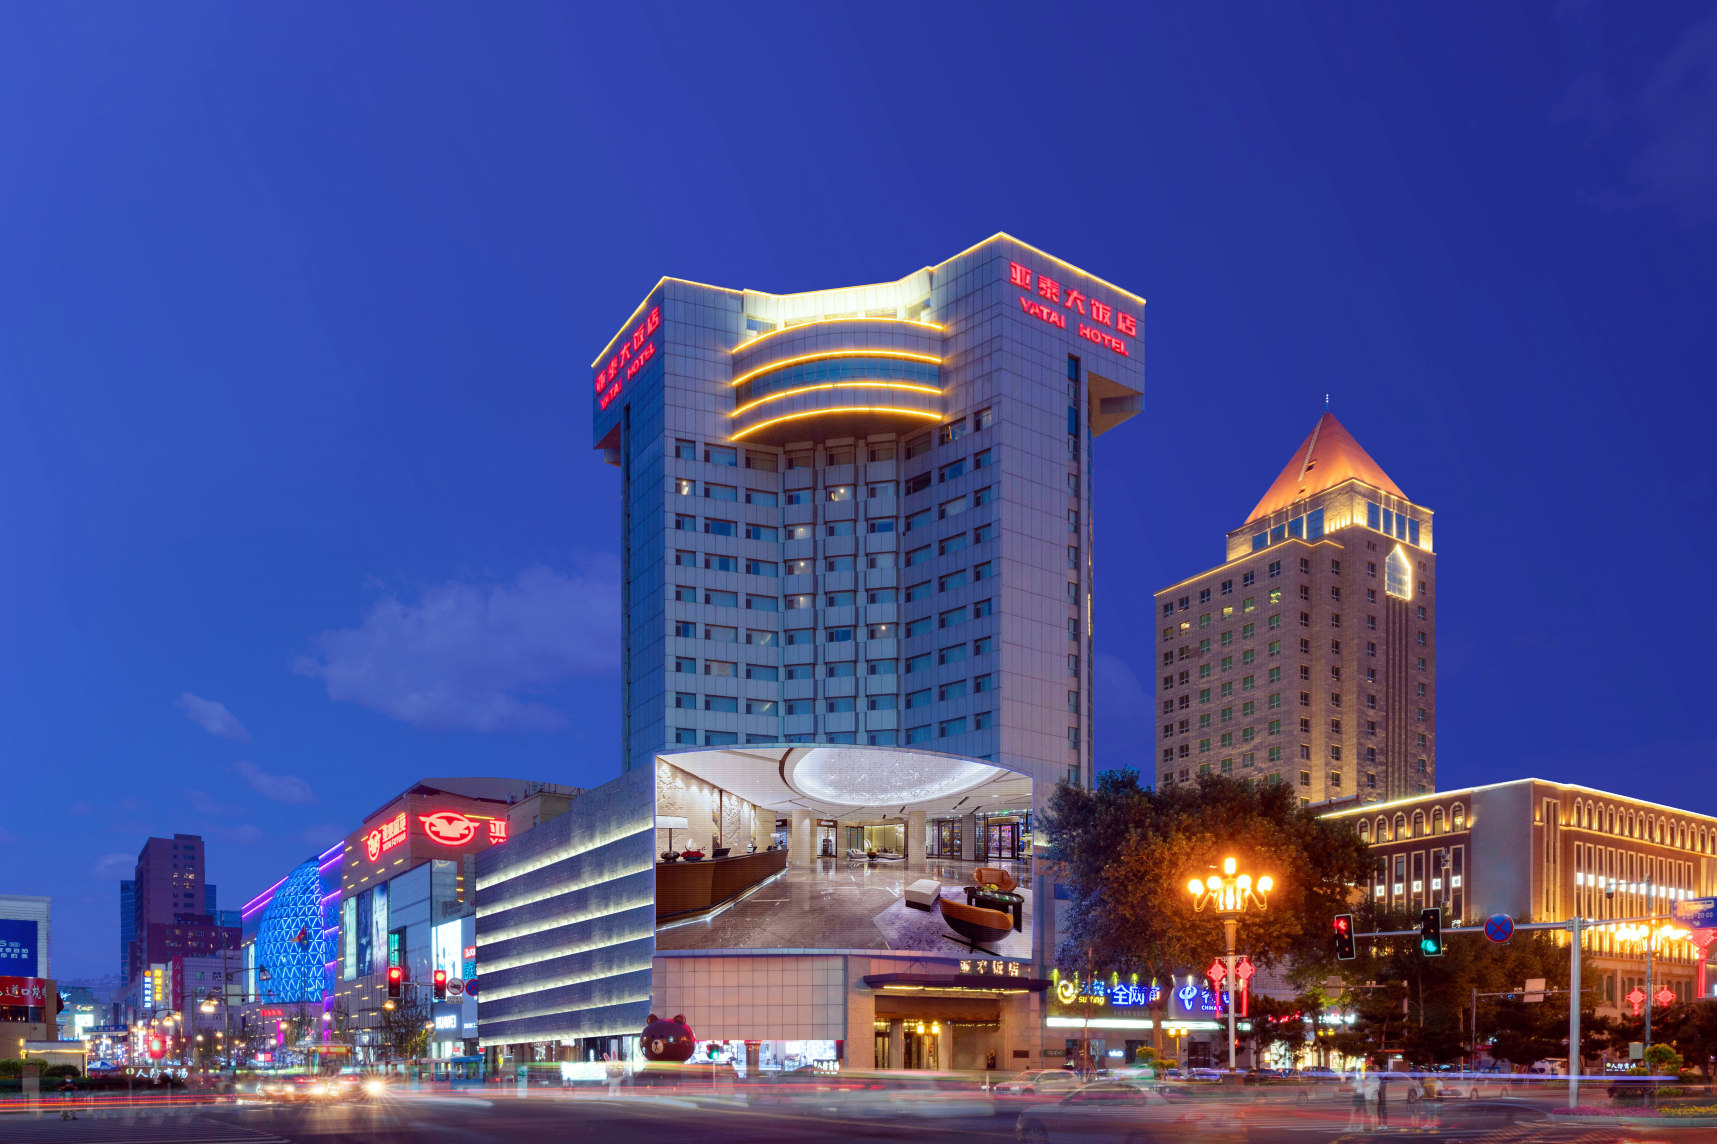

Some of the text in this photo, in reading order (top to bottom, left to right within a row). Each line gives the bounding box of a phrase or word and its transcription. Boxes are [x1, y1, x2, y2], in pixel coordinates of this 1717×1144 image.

[1010, 261, 1137, 337] 亚泰大饭店
[1019, 296, 1129, 357] YATAI HOTEL
[595, 306, 660, 393] 亚泰大饭店
[600, 342, 656, 411] YATAI HOTEL
[435, 1015, 457, 1030] HUAWEI
[1078, 995, 1105, 1006] sufing
